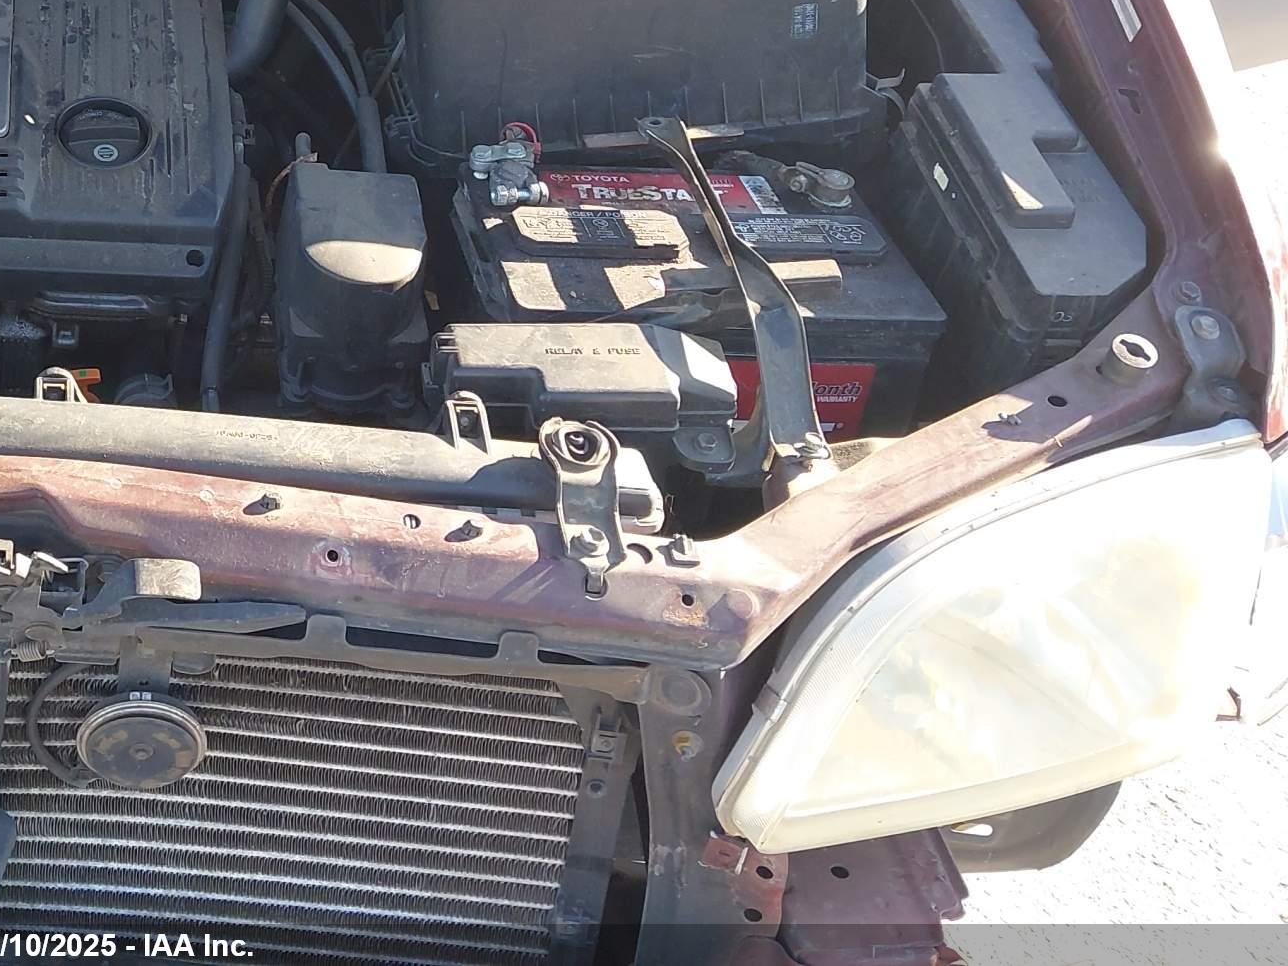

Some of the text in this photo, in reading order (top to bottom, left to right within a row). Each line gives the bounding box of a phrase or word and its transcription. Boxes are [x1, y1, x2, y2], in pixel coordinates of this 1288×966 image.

[573, 174, 630, 183] TOYOTA
[550, 209, 594, 219] DANGER
[544, 346, 584, 355] RELAY
[607, 346, 641, 355] FUSE
[812, 381, 863, 396] onth
[816, 395, 859, 403] WARRANTY
